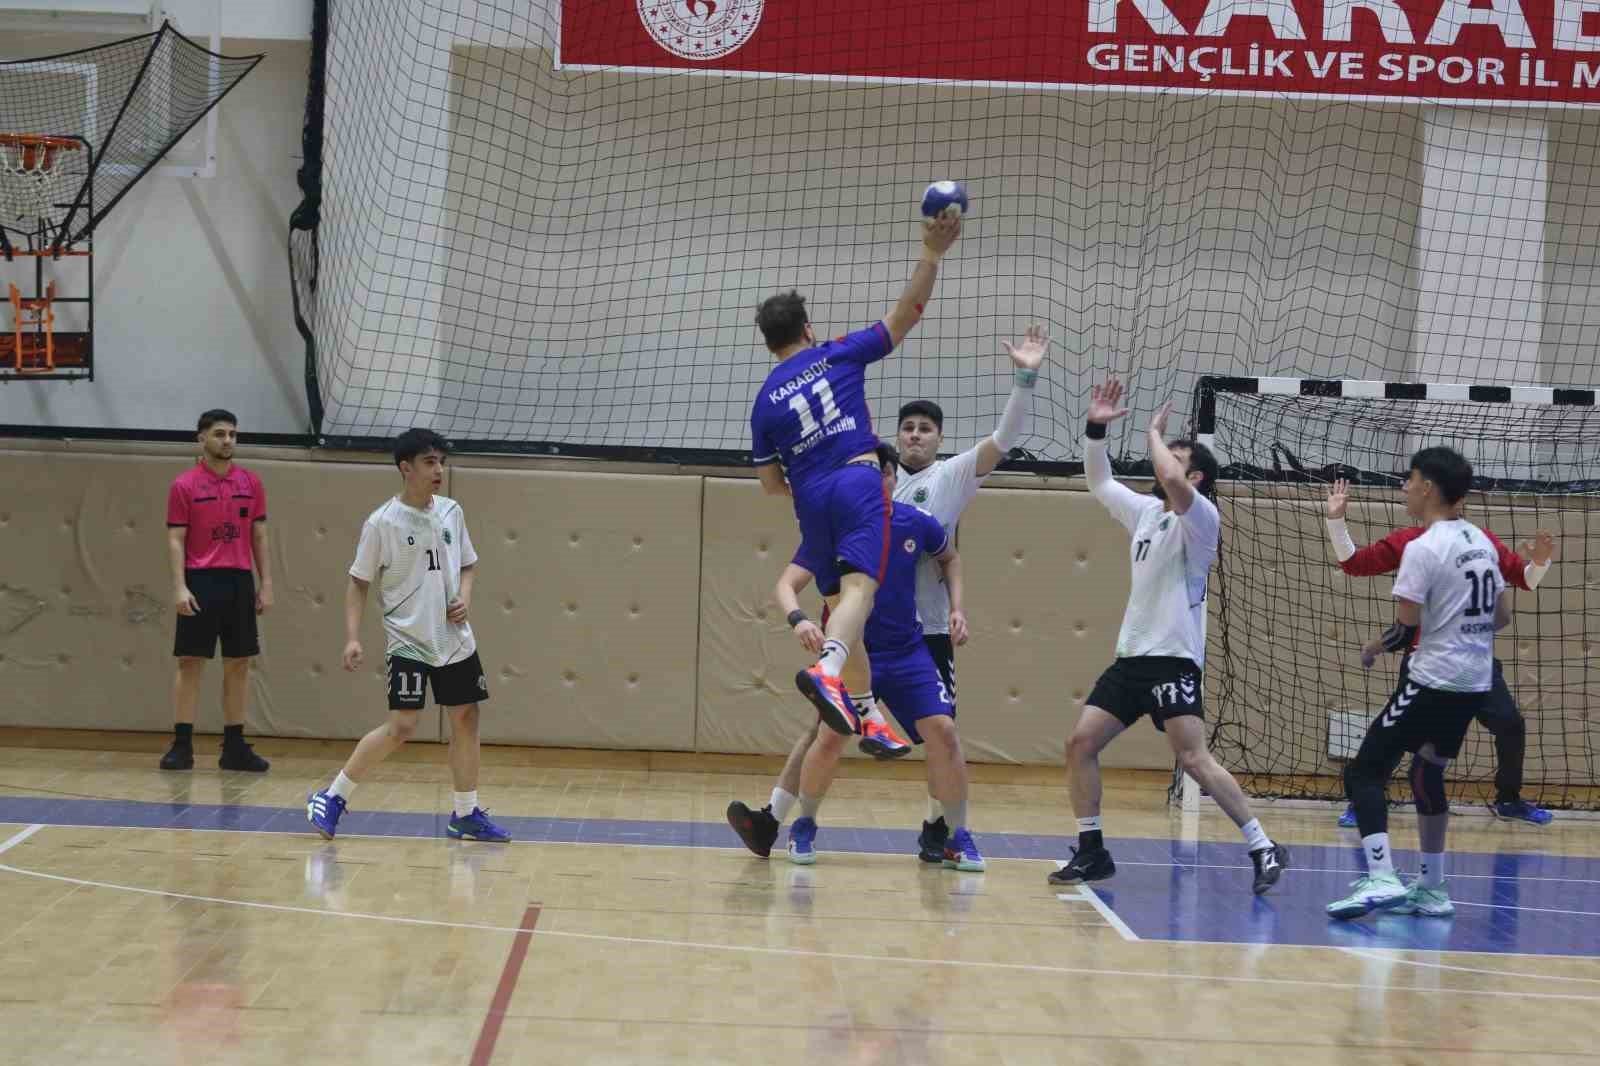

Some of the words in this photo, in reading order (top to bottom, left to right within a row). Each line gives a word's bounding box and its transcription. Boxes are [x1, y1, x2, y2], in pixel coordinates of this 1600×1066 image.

[1086, 42, 1295, 82] GENÇLİK
[1304, 50, 1365, 80] VE
[1377, 53, 1505, 86] SPOR
[1518, 52, 1560, 88] İL
[788, 377, 841, 439] 11
[1135, 539, 1151, 561] 17
[1463, 568, 1496, 616] 10
[397, 671, 423, 696] 11
